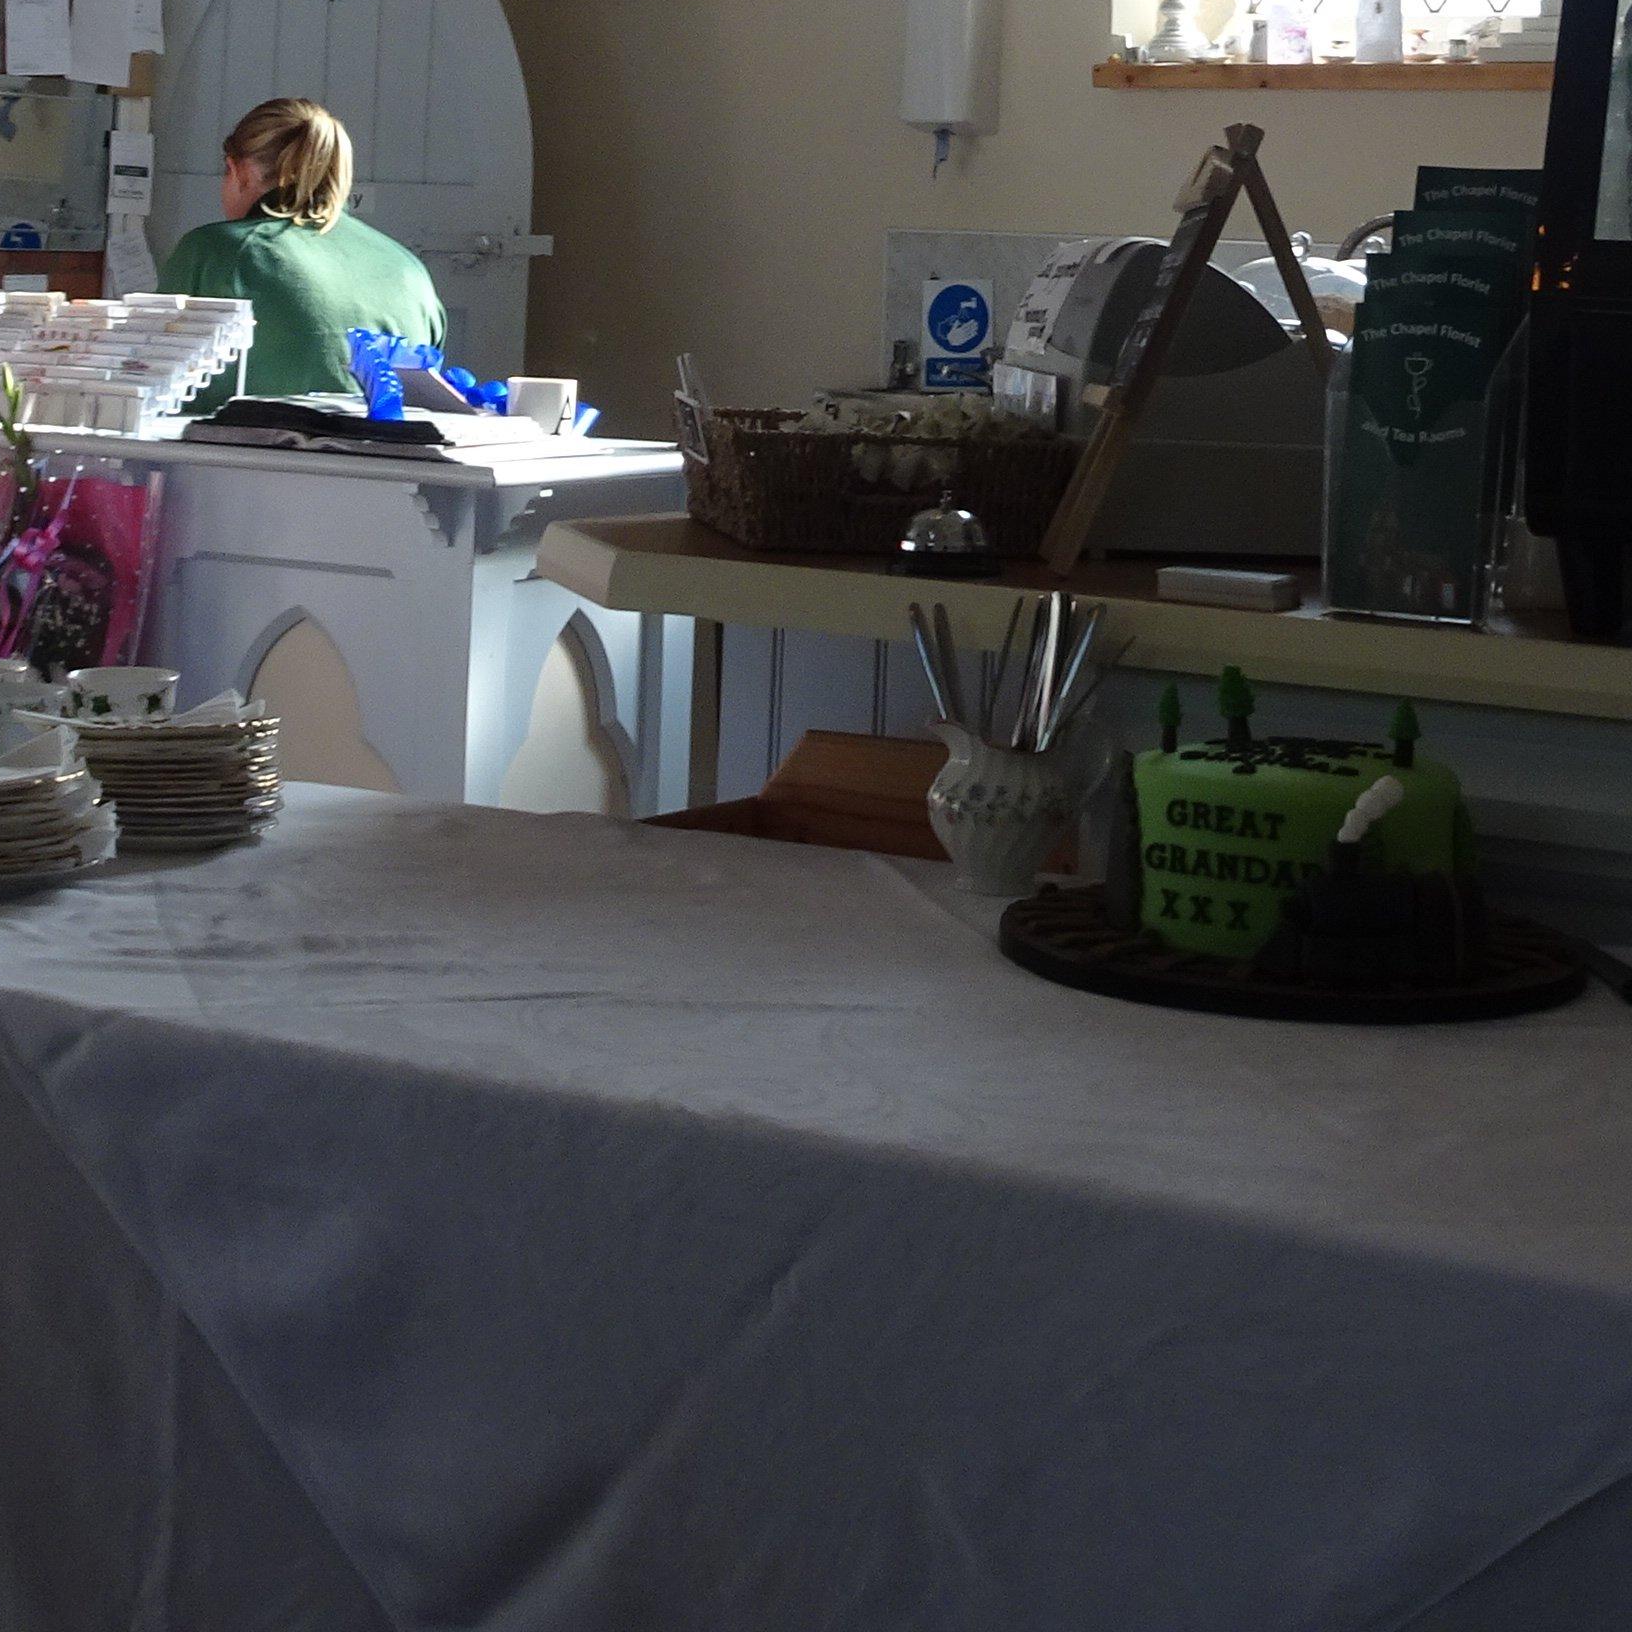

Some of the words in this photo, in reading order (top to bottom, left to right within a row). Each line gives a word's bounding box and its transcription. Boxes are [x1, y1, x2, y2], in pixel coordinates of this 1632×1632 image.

[1423, 188, 1449, 202] The
[1451, 183, 1498, 199] Chapel
[1399, 232, 1424, 249] The
[1426, 228, 1474, 242] Chapel
[1373, 276, 1399, 291] The
[1401, 271, 1449, 286] Chapel
[1360, 327, 1389, 343] The
[1390, 321, 1438, 337] Chapel
[1166, 799, 1285, 840] GREAT
